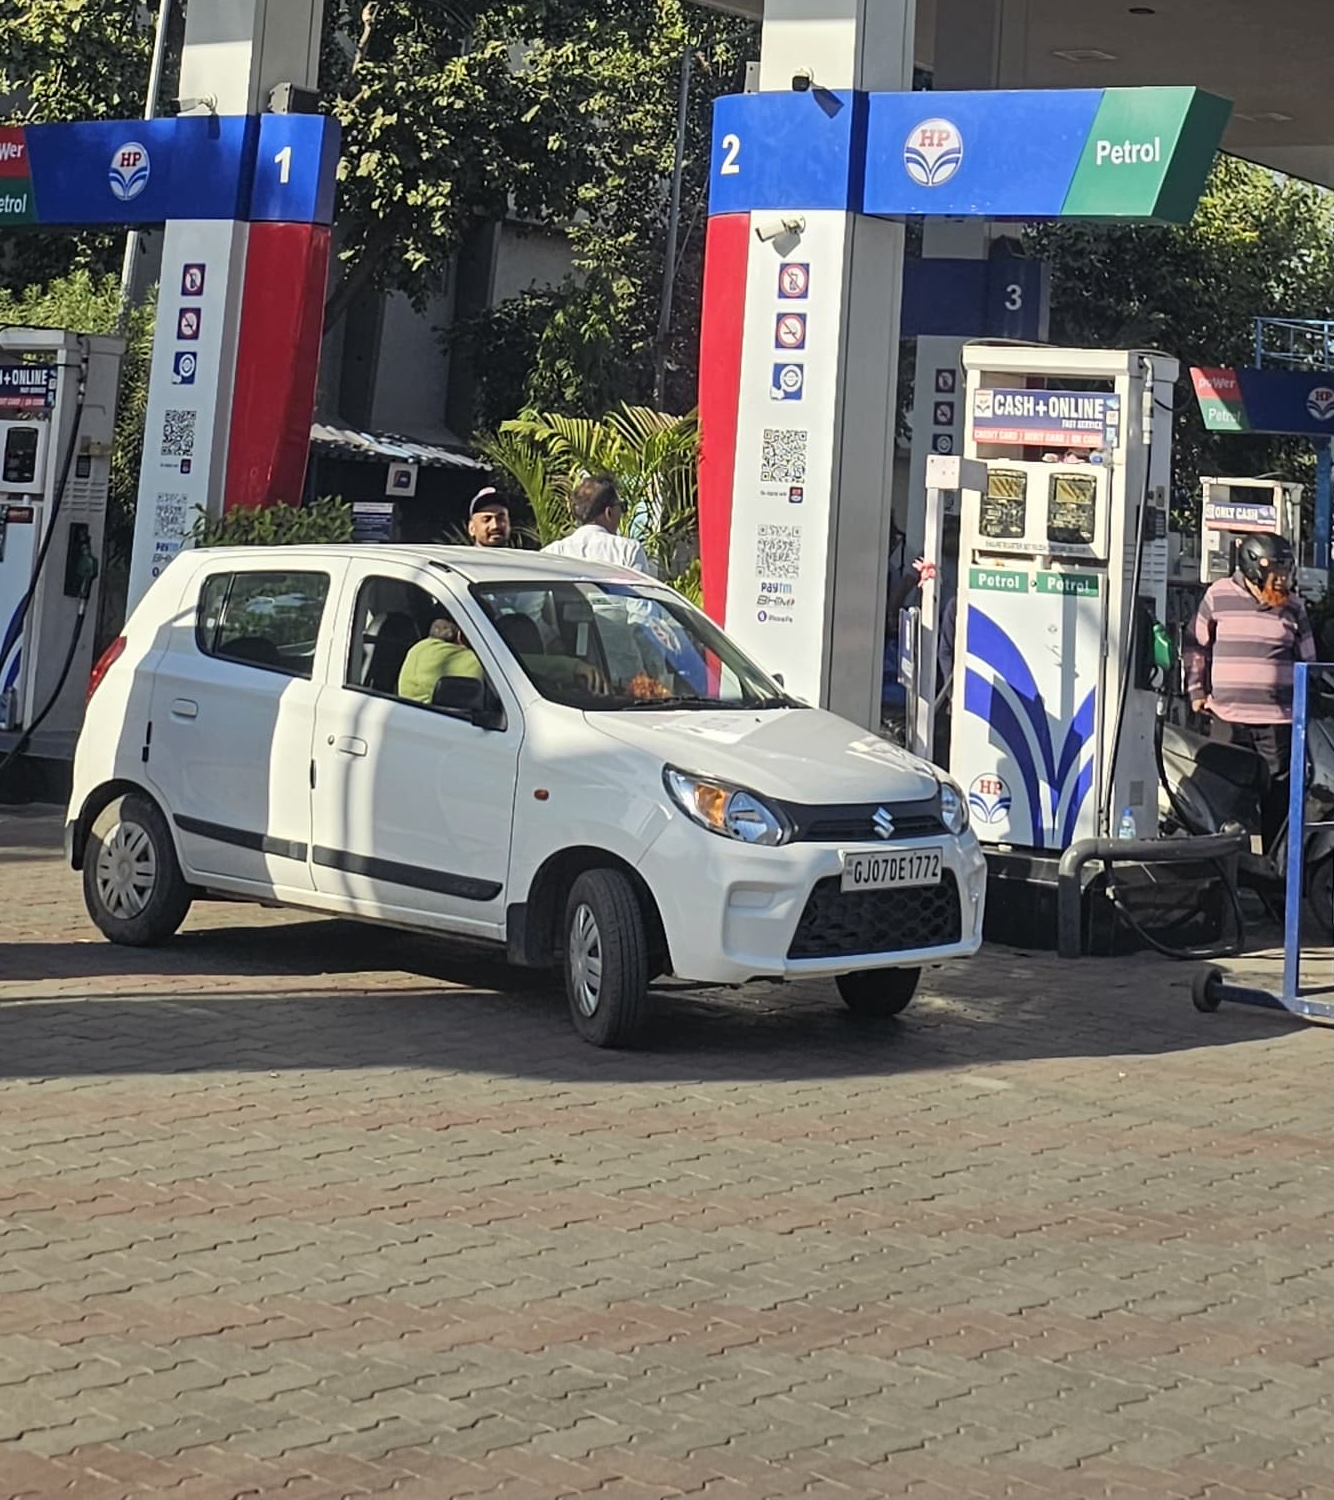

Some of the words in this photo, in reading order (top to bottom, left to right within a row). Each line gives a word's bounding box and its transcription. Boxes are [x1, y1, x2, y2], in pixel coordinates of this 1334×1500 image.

[919, 130, 951, 148] HP
[120, 152, 142, 167] HP
[721, 134, 740, 175] 2
[1096, 137, 1161, 165] Petrol
[274, 147, 292, 183] 1
[1005, 284, 1022, 310] 3
[1208, 407, 1242, 422] Petrol
[1215, 506, 1235, 520] ONLY
[1236, 506, 1258, 521] CASH
[978, 572, 1020, 589] Petrol
[1047, 575, 1090, 594] Petrol
[979, 779, 1003, 795] HP
[854, 854, 940, 884] GJ07DE1772
